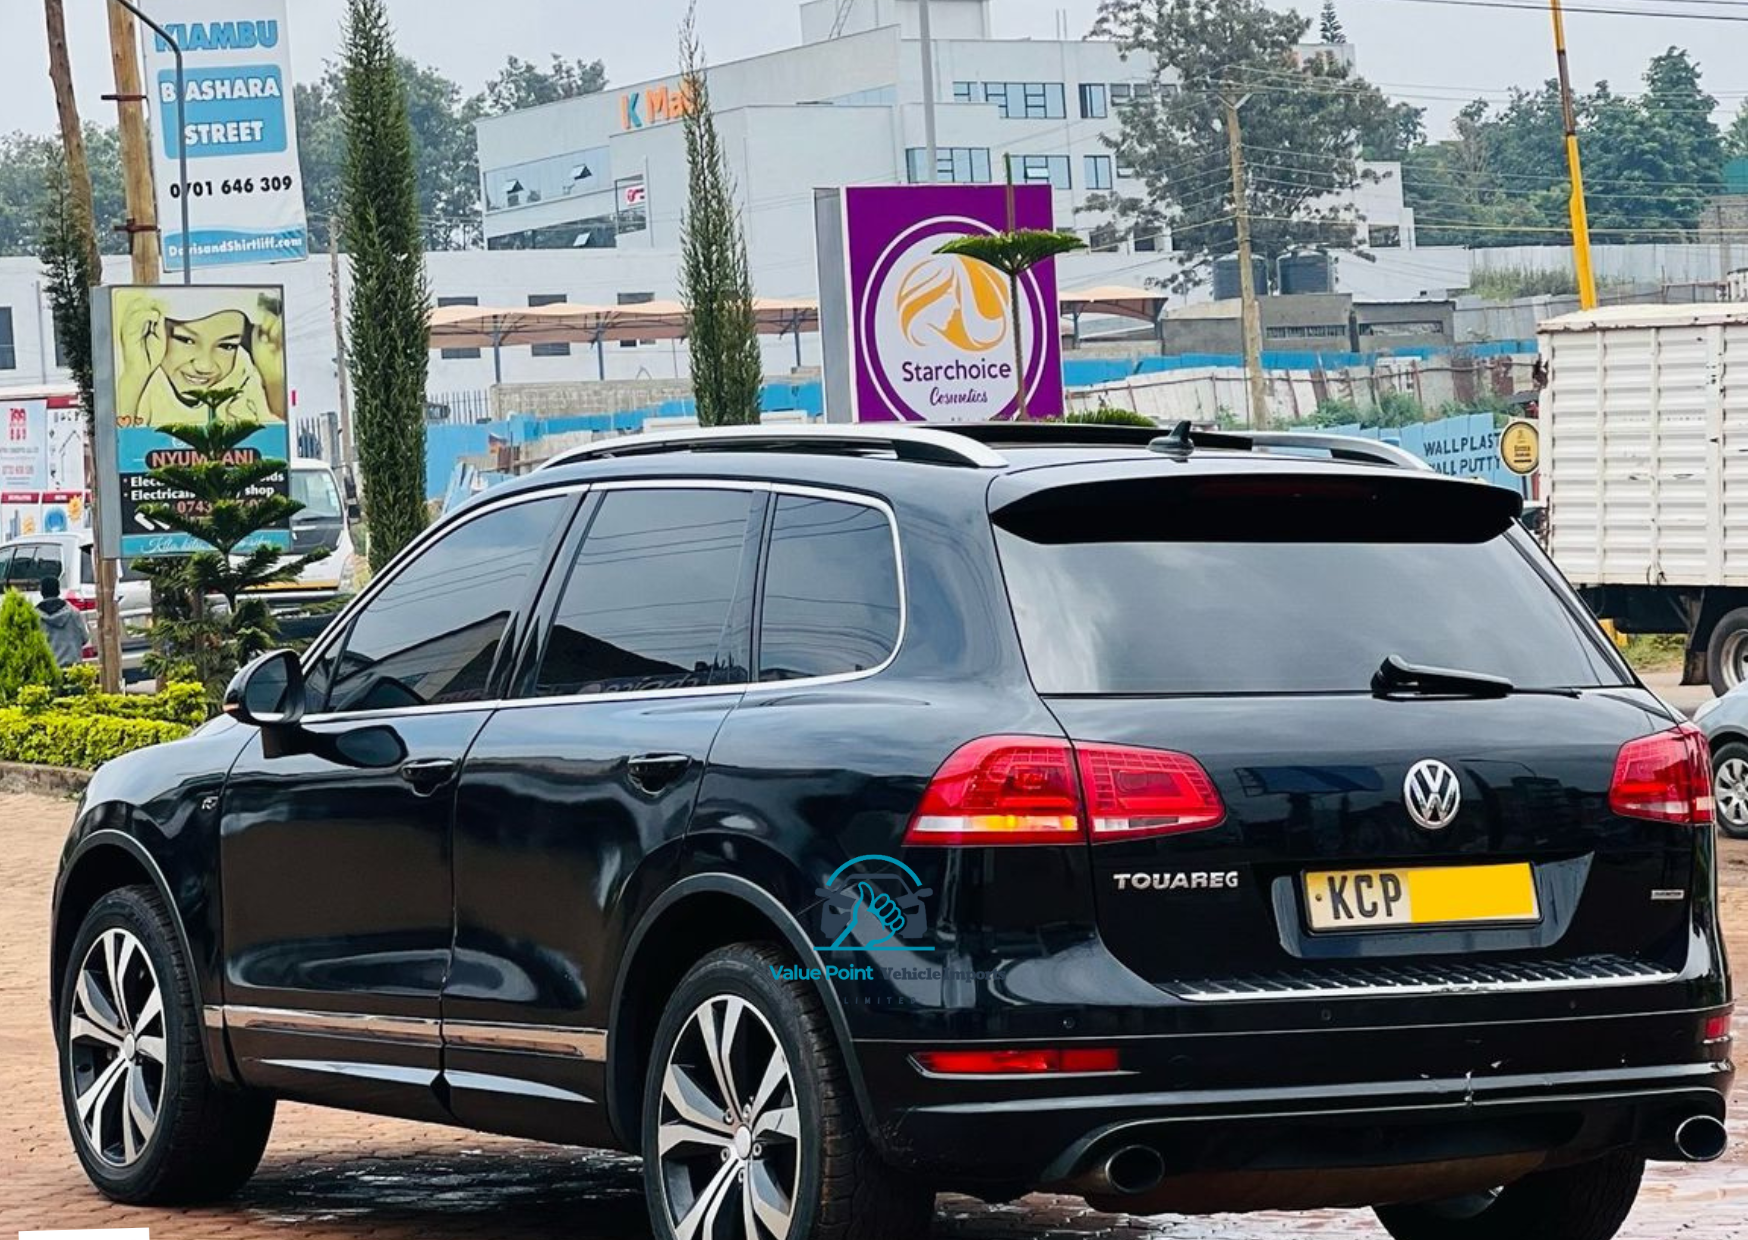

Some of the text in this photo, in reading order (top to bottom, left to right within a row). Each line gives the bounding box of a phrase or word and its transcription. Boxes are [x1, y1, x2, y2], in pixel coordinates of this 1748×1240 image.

[155, 20, 279, 52] KIAMBU
[160, 77, 281, 103] BASHARA
[621, 92, 642, 130] K
[184, 120, 264, 146] STREET
[221, 178, 254, 194] 646
[260, 175, 292, 191] 309
[902, 358, 1012, 382] Starchoice
[929, 386, 988, 406] Cosmetics
[152, 450, 254, 467] NYUMANI
[1460, 455, 1500, 474] PUTTY
[245, 484, 275, 498] shop
[1113, 870, 1239, 891] TOUAREG
[1327, 872, 1403, 920] KCP
